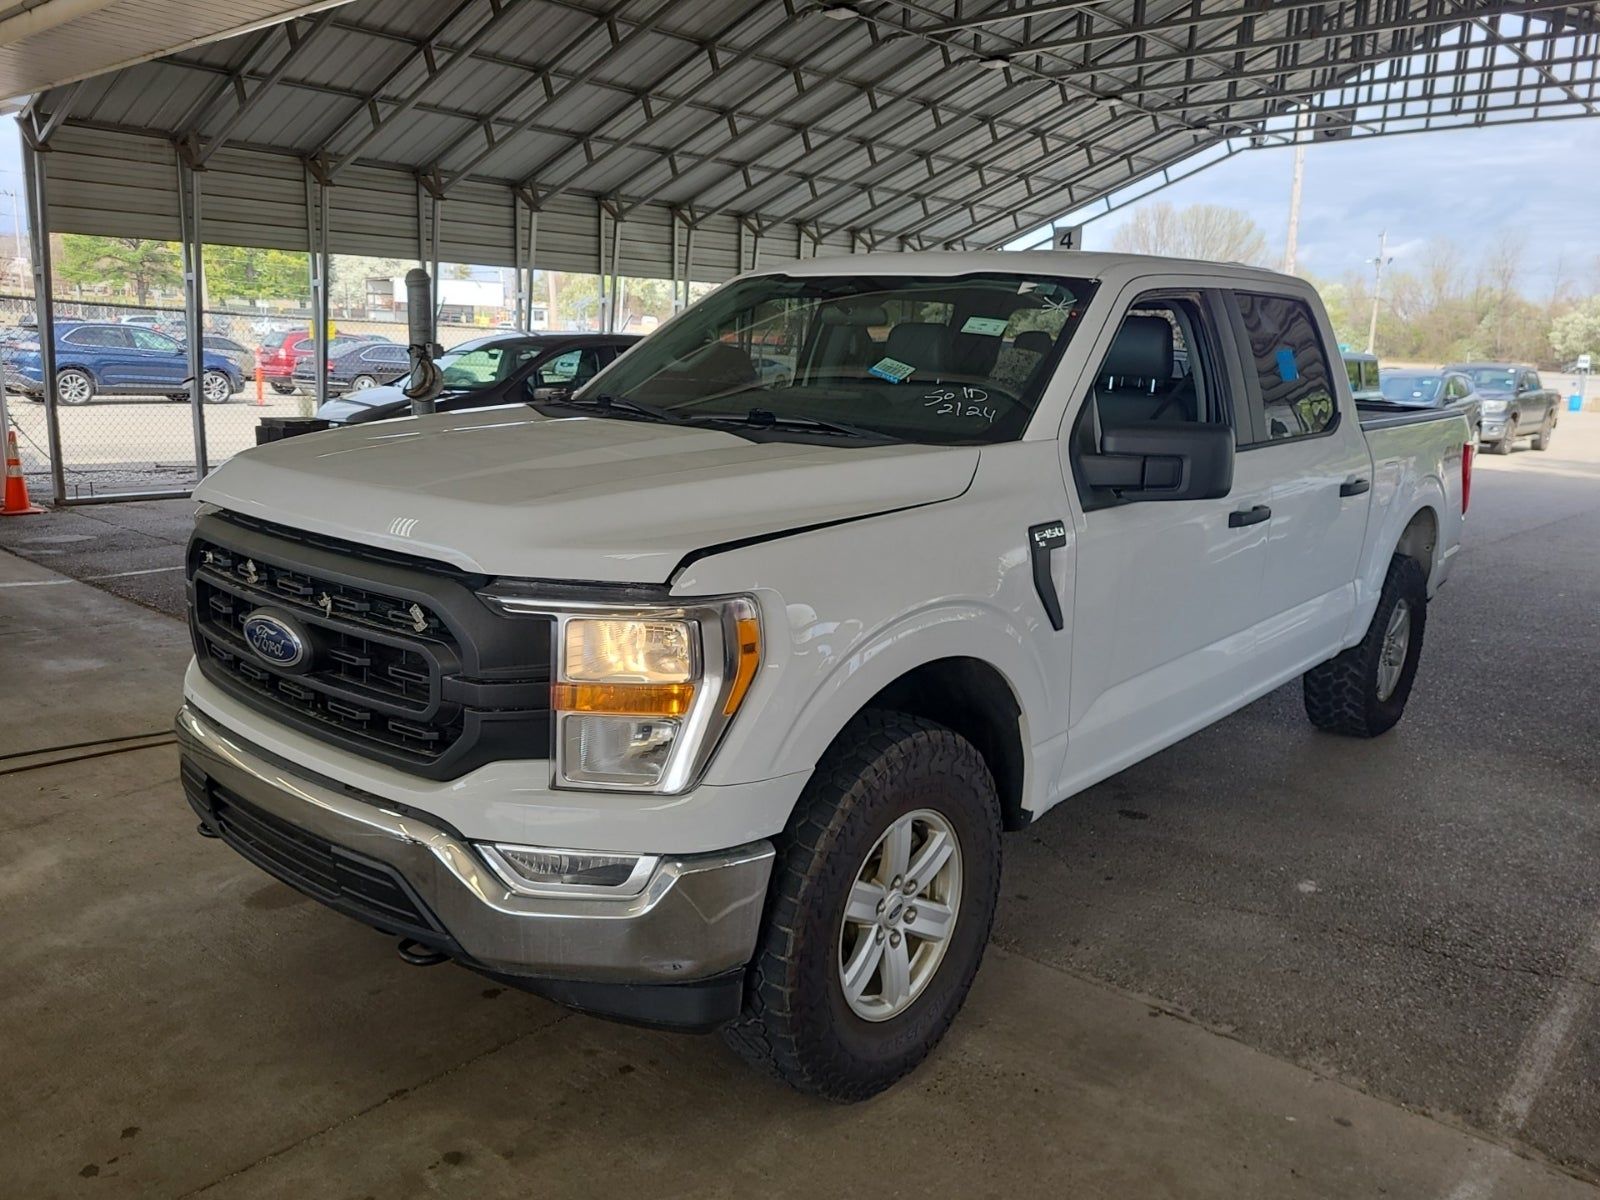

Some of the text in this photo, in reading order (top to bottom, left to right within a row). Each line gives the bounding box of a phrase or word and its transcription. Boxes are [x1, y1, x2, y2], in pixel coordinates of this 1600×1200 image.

[1060, 231, 1073, 250] 4
[1034, 526, 1065, 542] F-150
[253, 624, 285, 657] Ford
